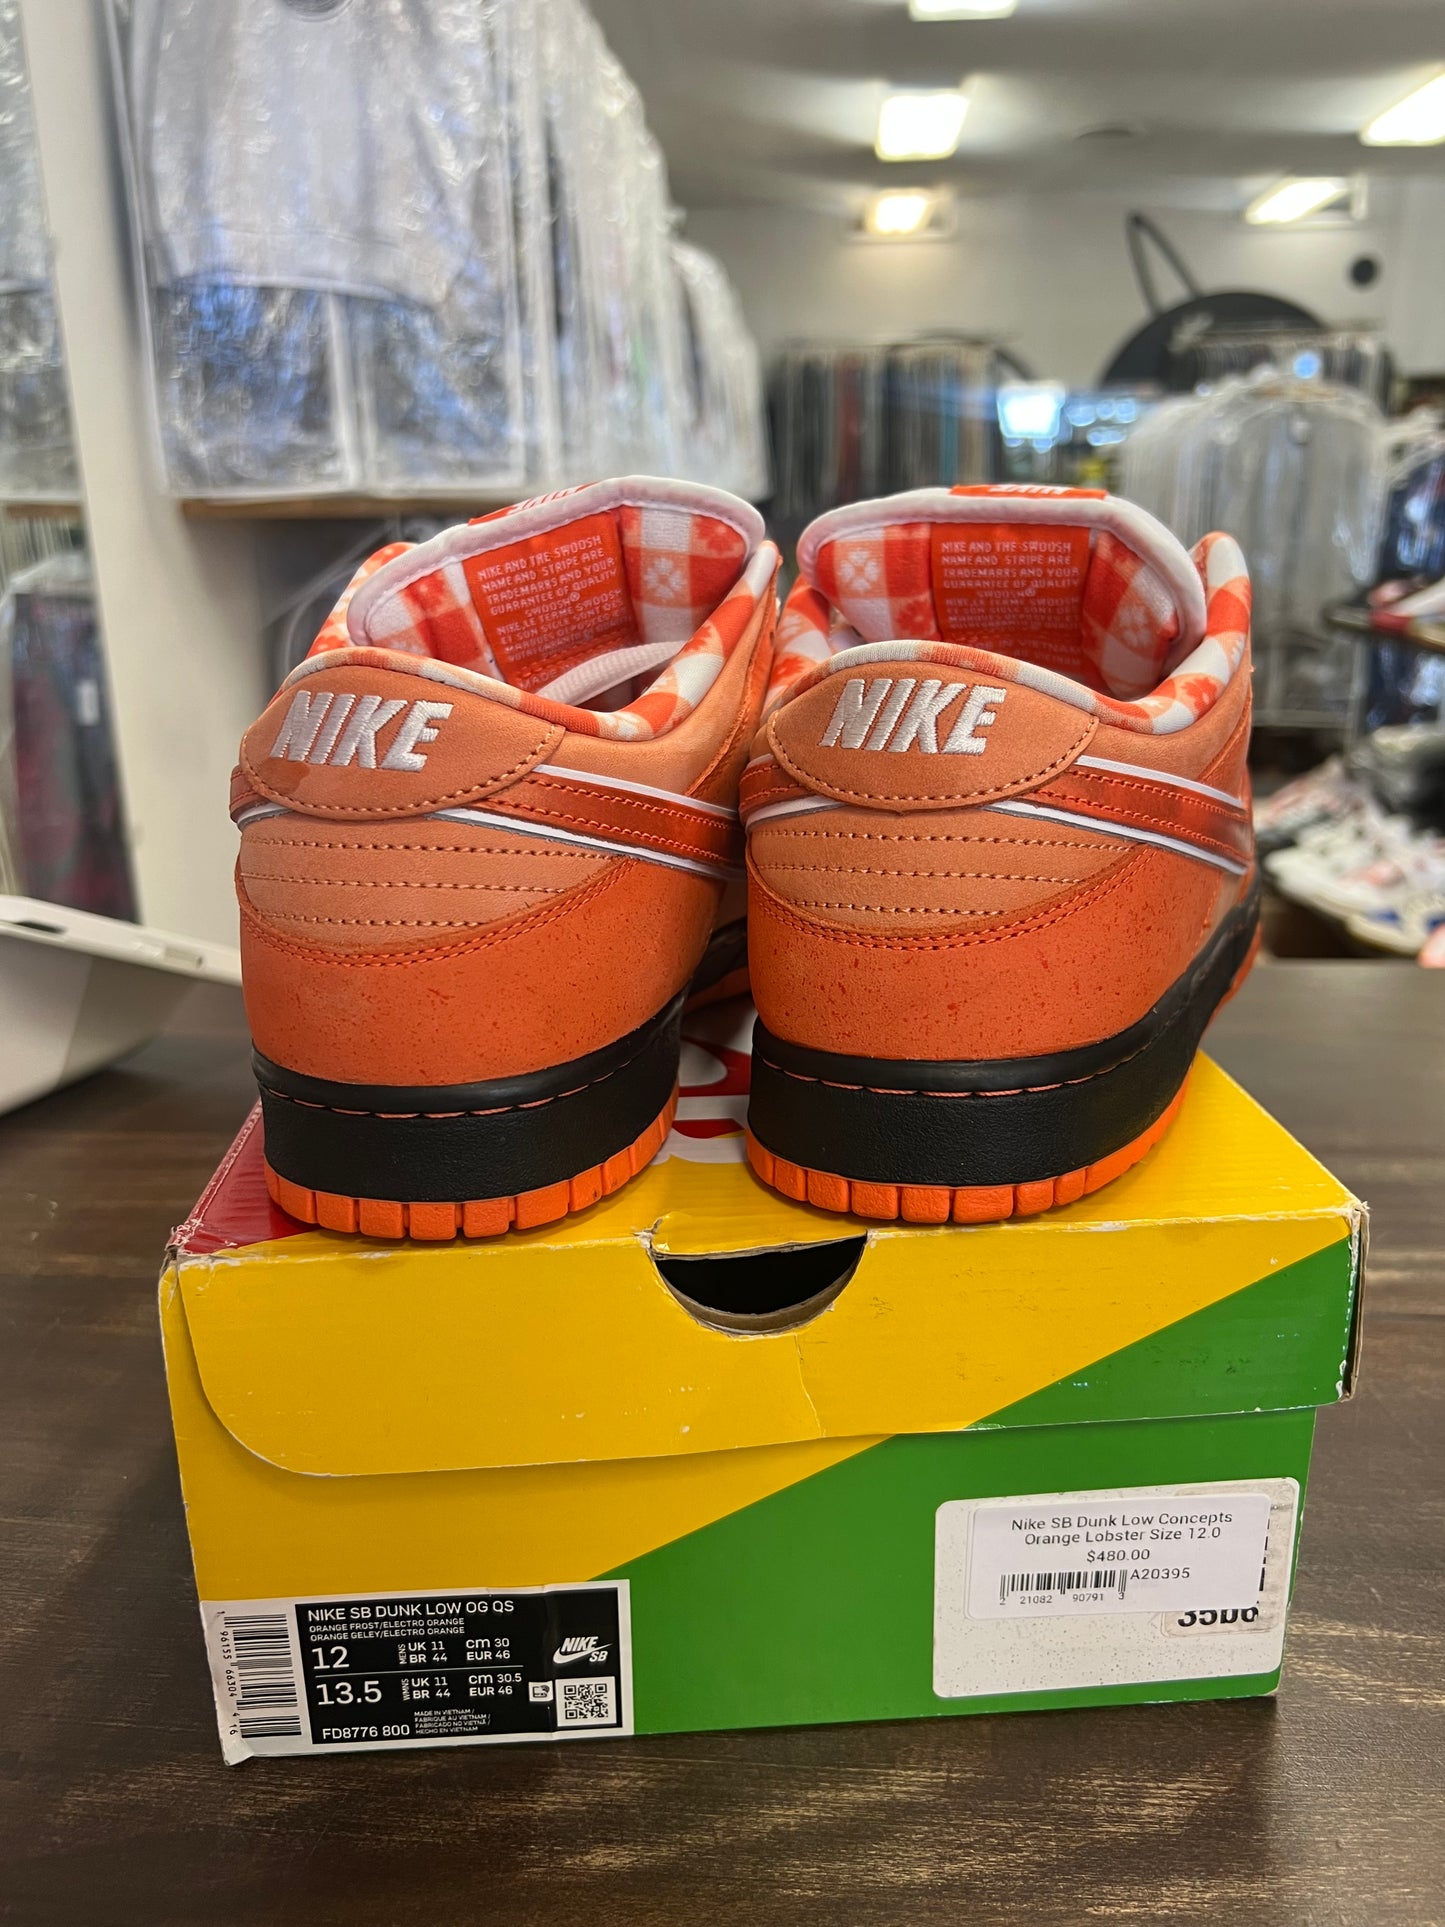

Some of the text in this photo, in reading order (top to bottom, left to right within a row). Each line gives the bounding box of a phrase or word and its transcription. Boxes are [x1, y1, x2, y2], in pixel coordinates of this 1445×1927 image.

[941, 541, 1072, 553] NIKE AND THE SWOOSH
[477, 564, 502, 581] NIKE
[504, 558, 528, 574] AND
[554, 535, 602, 557] SWOOSH
[941, 554, 1071, 566] NAME AND STRIPE ARE
[482, 548, 605, 593] NAME AND STRIPE ARE
[560, 569, 582, 584] AND
[584, 557, 615, 575] YOUR
[1020, 567, 1043, 578] AND
[1013, 579, 1027, 588] OF
[490, 568, 617, 616] GUARANTEE OF QUALITY
[818, 678, 1007, 756] NIKE
[269, 690, 454, 773] NIKE
[1011, 1511, 1233, 1531] Nike SB Dunk Low Concepts
[1024, 1526, 1221, 1547] Orange Lobster Size 12.0
[1086, 1548, 1150, 1563] $480.00
[1129, 1567, 1191, 1581] A20395
[1019, 1594, 1054, 1605] 21082
[1072, 1592, 1104, 1602] 90791
[1118, 1590, 1126, 1600] 3
[308, 1600, 515, 1622] NIKE SB DUNK LOW OG QS
[309, 1617, 465, 1633] ORANGE FROST/ELECTRO ORANGE
[310, 1632, 349, 1642] ORANGE
[427, 1626, 465, 1636] ORANGE
[220, 1630, 232, 1660] 96155
[408, 1640, 445, 1652] UK 11
[465, 1637, 510, 1649] cm 30
[560, 1636, 599, 1652] NIKE
[311, 1645, 350, 1670] 12
[409, 1652, 448, 1664] BR 44
[466, 1649, 511, 1661] EUR 46
[589, 1650, 609, 1663] SB
[225, 1669, 238, 1698] 66304
[411, 1676, 448, 1688] UK 11
[468, 1673, 523, 1685] cm 30.5
[315, 1680, 382, 1706] 13.5
[412, 1688, 451, 1700] BR 44
[469, 1685, 513, 1697] EUR 46
[322, 1724, 410, 1740] FD8776 800
